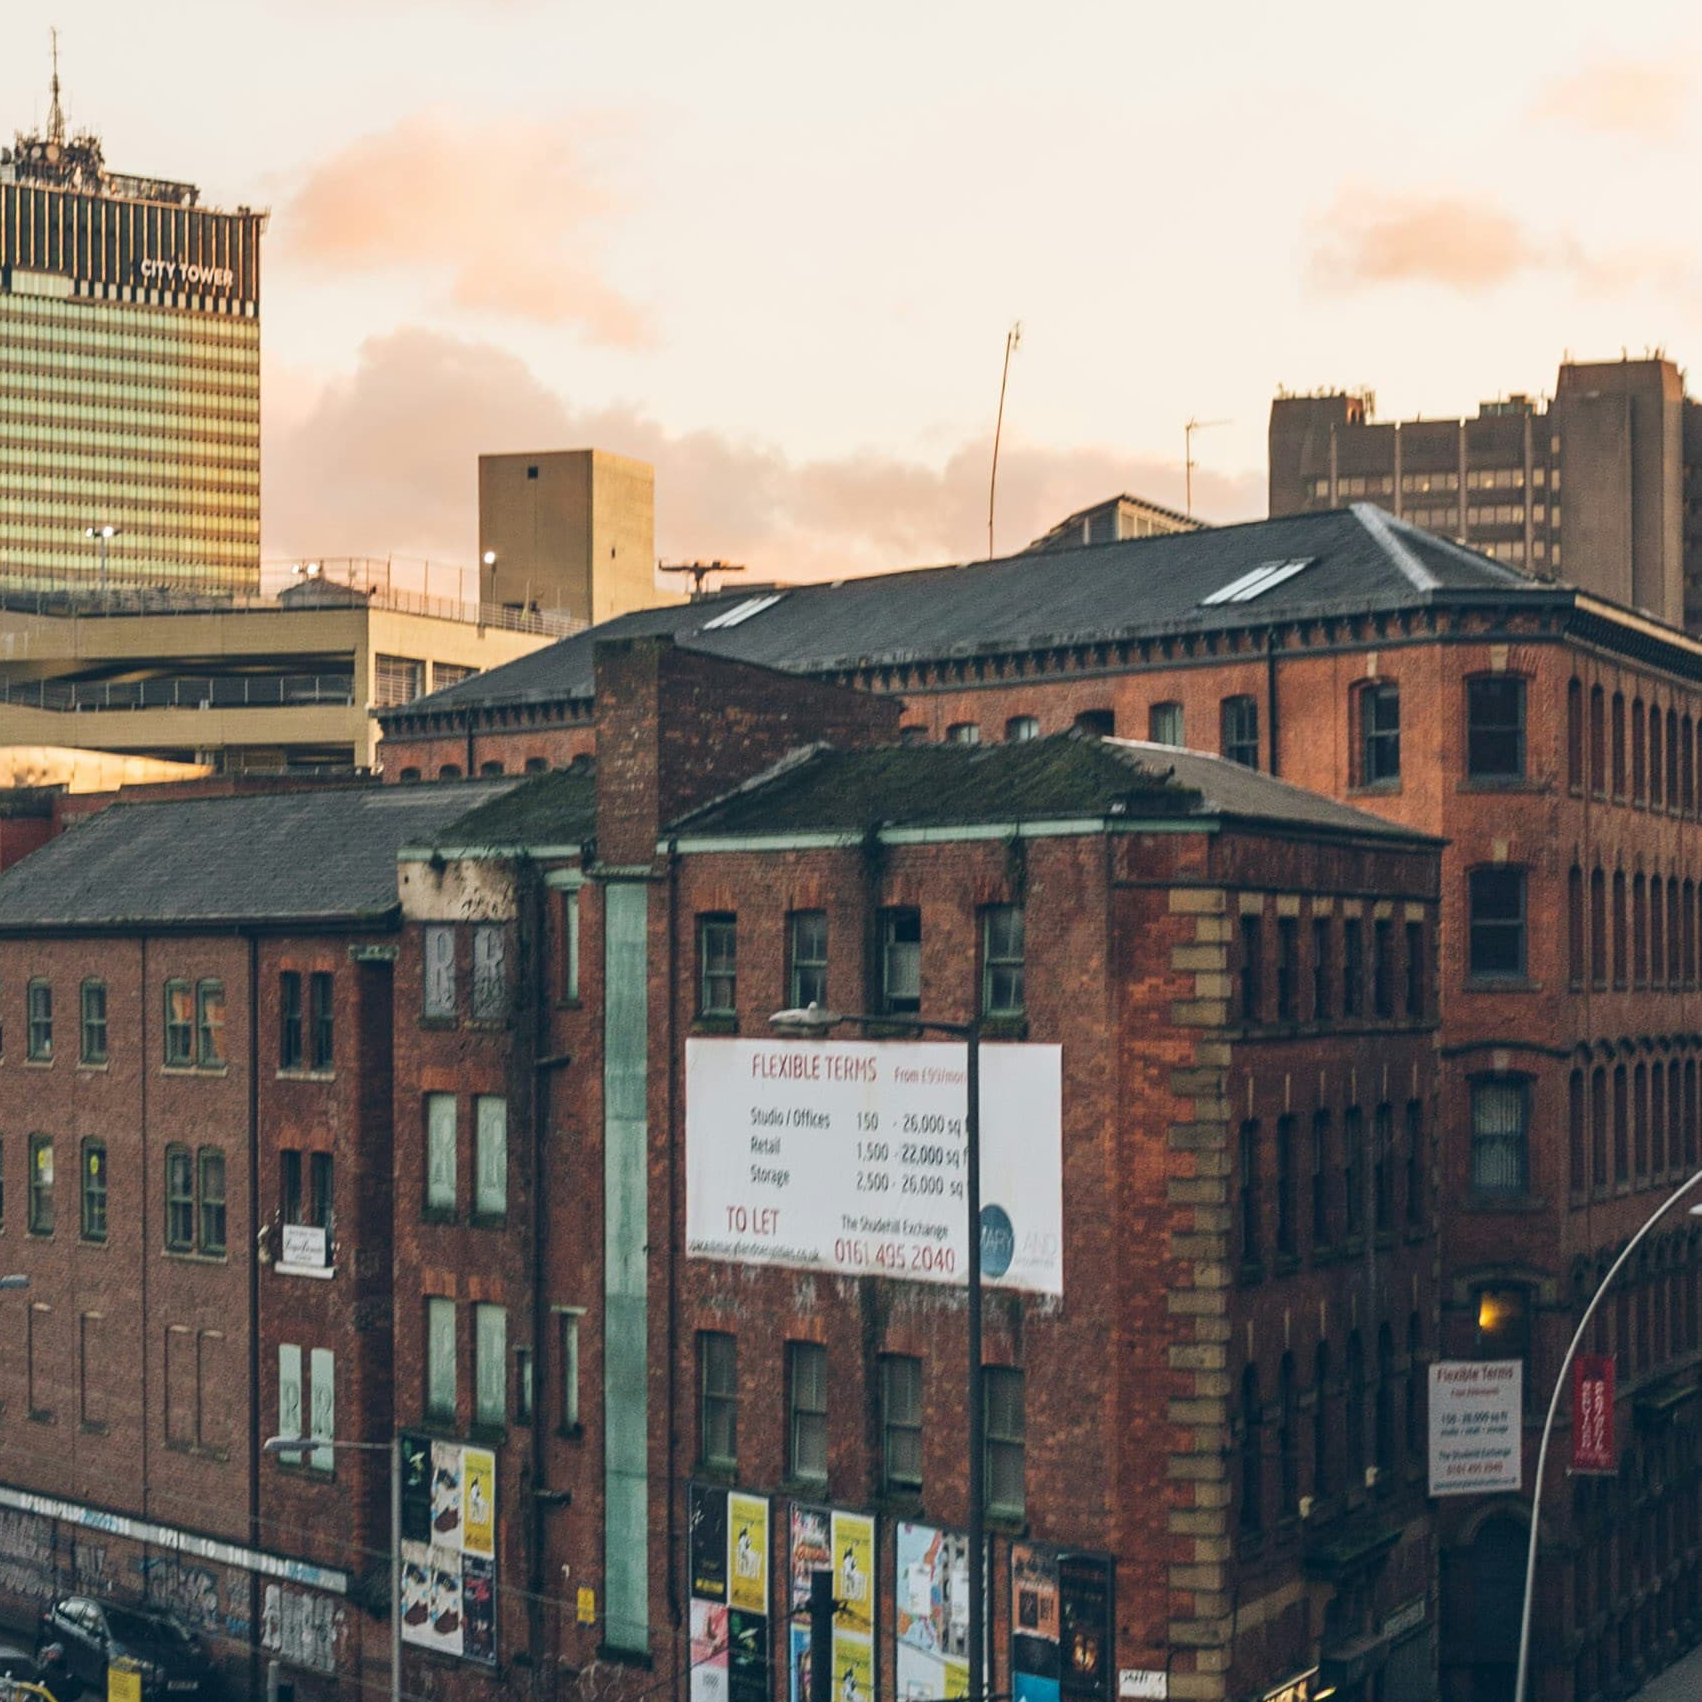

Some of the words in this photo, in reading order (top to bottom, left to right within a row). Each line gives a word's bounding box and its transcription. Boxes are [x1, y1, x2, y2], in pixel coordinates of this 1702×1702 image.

[140, 258, 176, 280] CITY
[179, 262, 234, 288] TOWER
[751, 1053, 821, 1080] FLEXIBLE
[824, 1055, 878, 1083] TERMS
[750, 1106, 784, 1128] Studio
[792, 1108, 831, 1130] Offices
[856, 1111, 879, 1132] 150
[902, 1113, 945, 1135] 26,000
[947, 1118, 962, 1139] sq
[750, 1135, 782, 1156] Retail
[856, 1142, 889, 1163] 1,500
[901, 1144, 944, 1166] 22,000
[946, 1150, 960, 1169] sq
[750, 1164, 791, 1189] Storage
[856, 1172, 889, 1192] 2,500
[901, 1174, 944, 1196] 26,000
[726, 1205, 747, 1233] TO
[751, 1208, 780, 1235] LET
[841, 1213, 857, 1231] The
[902, 1218, 950, 1241] Exchange
[834, 1238, 871, 1267] 0161
[874, 1242, 907, 1269] 495
[911, 1244, 956, 1274] 2040
